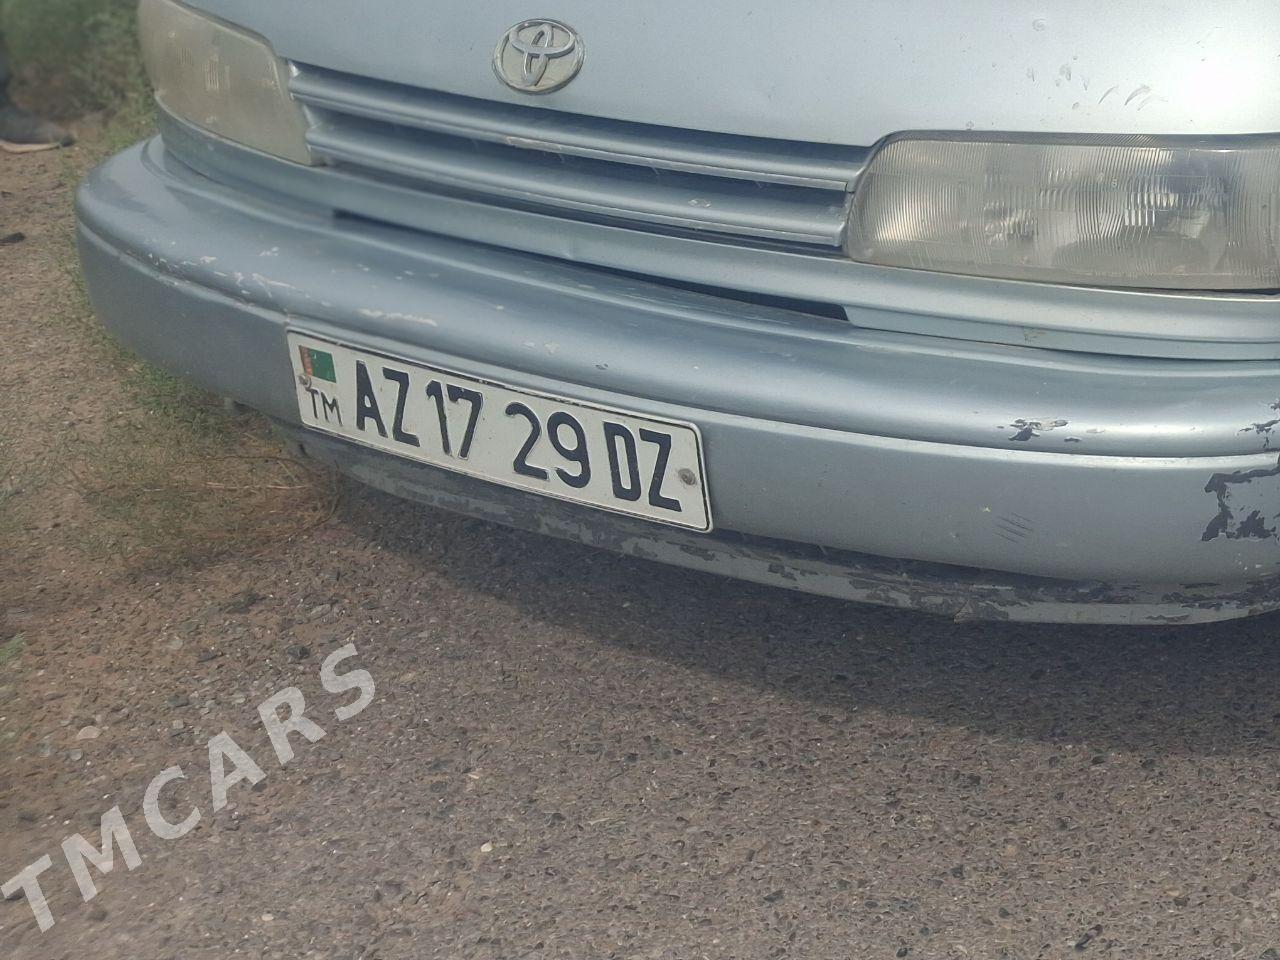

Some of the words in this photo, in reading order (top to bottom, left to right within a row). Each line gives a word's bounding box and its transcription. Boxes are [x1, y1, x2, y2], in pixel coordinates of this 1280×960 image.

[304, 387, 343, 427] TM
[504, 401, 592, 489] 29
[602, 420, 683, 513] DZ
